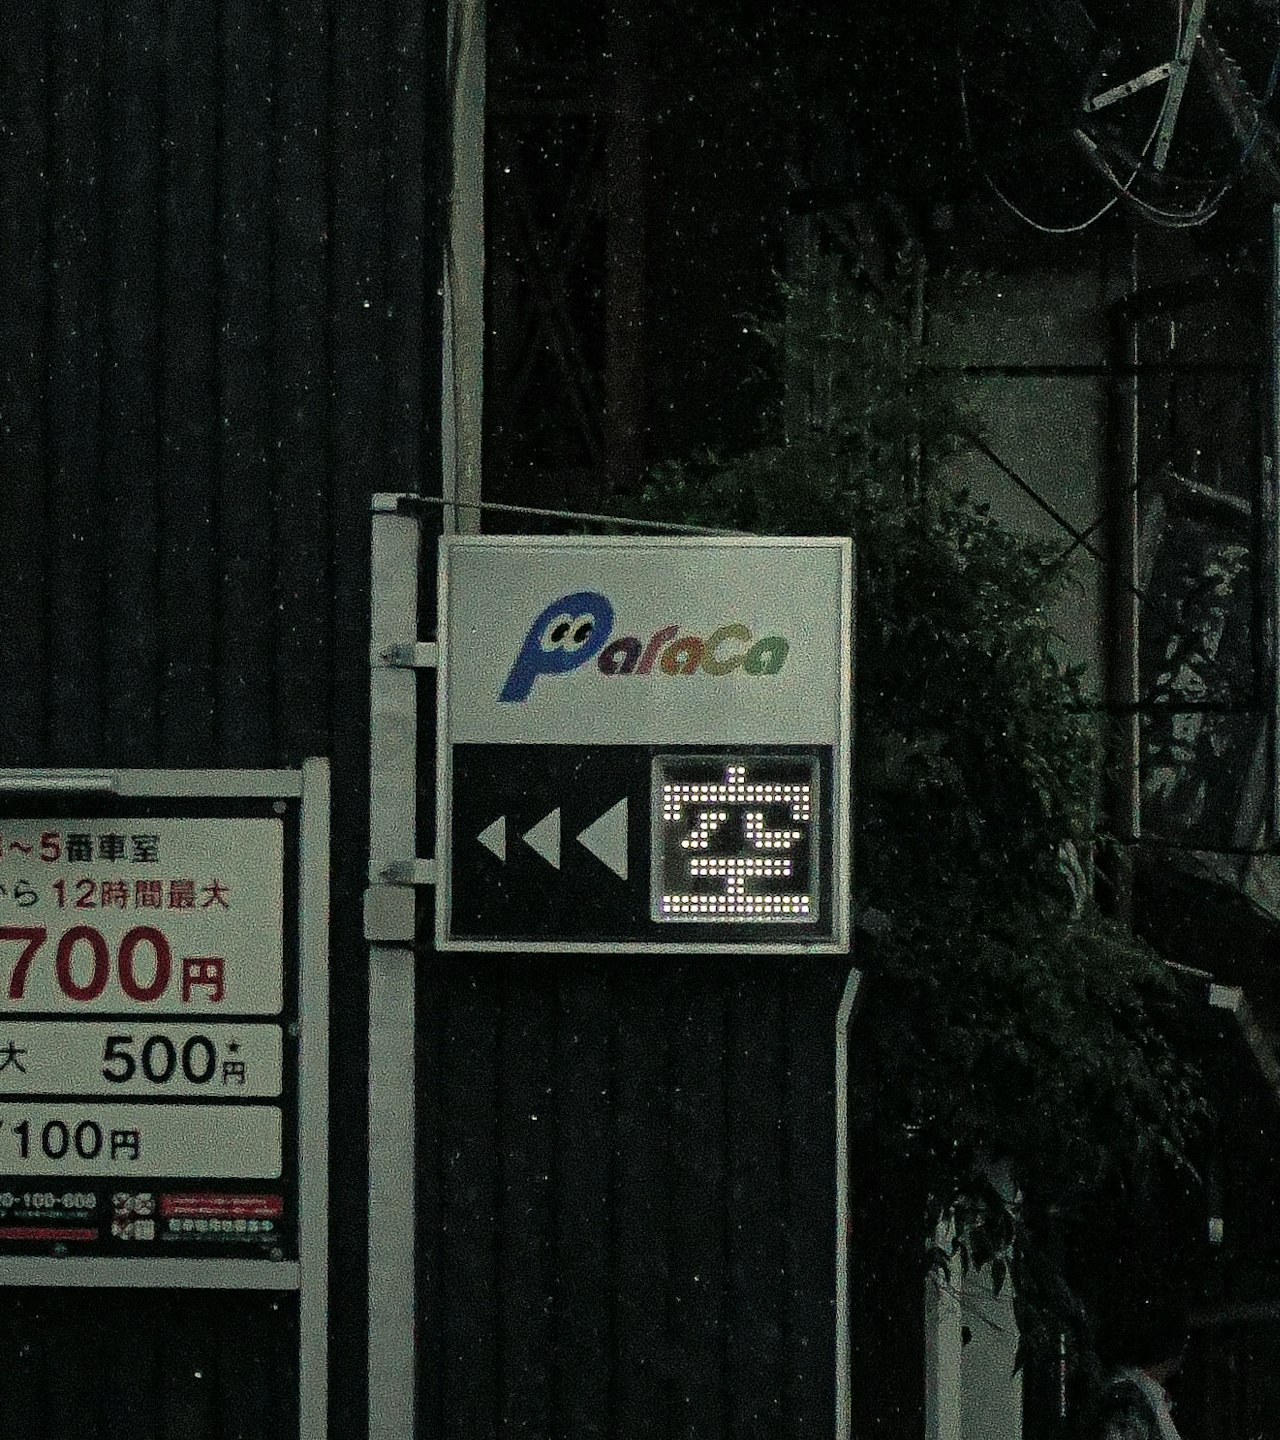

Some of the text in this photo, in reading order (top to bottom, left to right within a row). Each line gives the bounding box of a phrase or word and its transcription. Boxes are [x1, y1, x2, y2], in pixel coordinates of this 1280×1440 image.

[661, 764, 812, 915] 空
[102, 1034, 246, 1085] 500円
[13, 1119, 141, 1161] 100円
